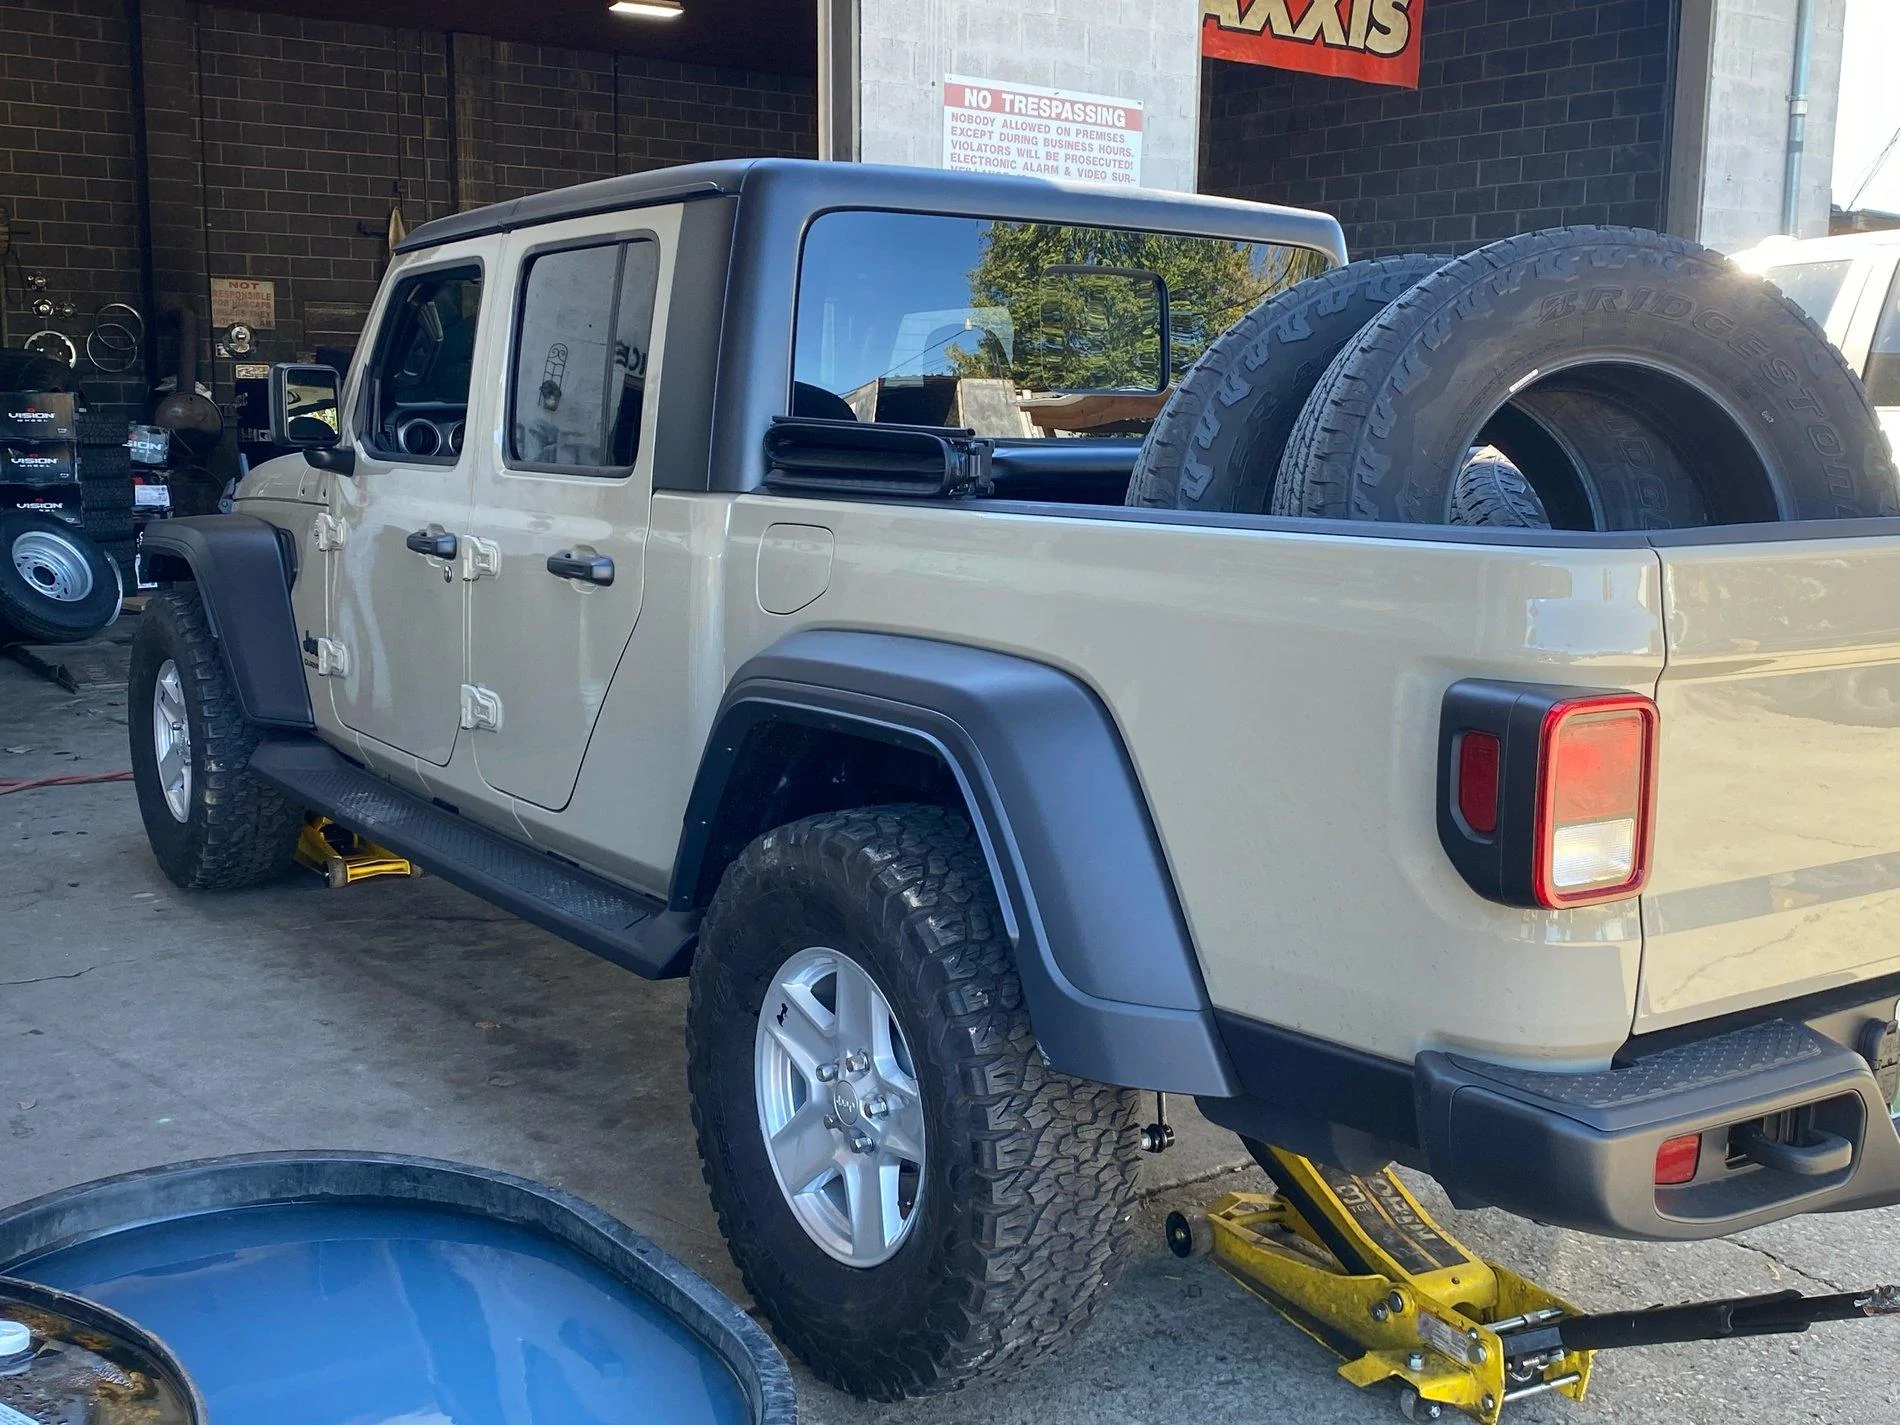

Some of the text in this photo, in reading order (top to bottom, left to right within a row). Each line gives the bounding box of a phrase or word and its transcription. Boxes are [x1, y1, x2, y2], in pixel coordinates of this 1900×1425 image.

[964, 87, 1126, 128] NO TRESPASSING
[951, 112, 1125, 144] NOBODY ALLOWED ON PREMISES
[951, 126, 1134, 158] EXCEPT DURING BUSINESS HOURS.
[950, 153, 1017, 170] ELECTRONIC
[1022, 162, 1059, 175] ALARM
[1064, 167, 1071, 177] &
[1077, 168, 1107, 181] VIDEO
[1111, 172, 1136, 184] SUR-
[951, 140, 1133, 170] VIOLATORS WILL BE PROSECUTED!
[212, 289, 272, 301] RESPONSIBLE
[228, 281, 260, 290] NOT
